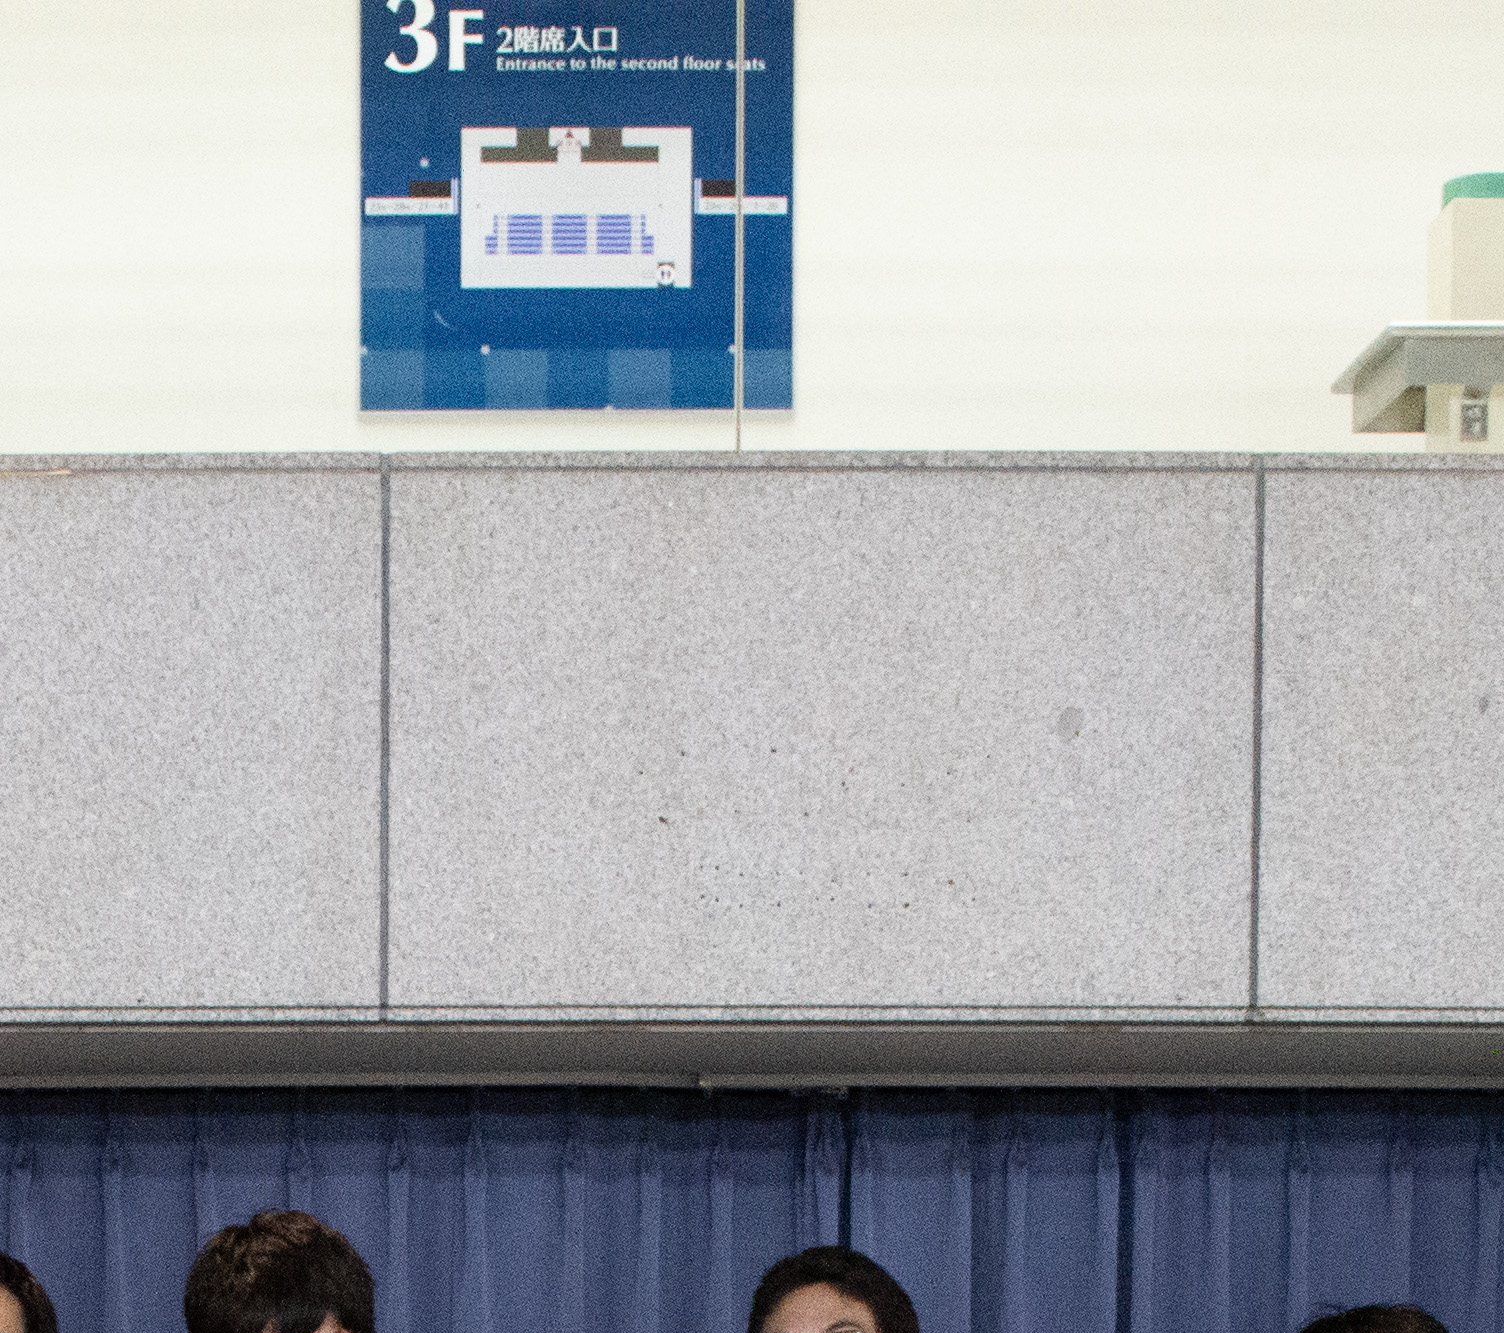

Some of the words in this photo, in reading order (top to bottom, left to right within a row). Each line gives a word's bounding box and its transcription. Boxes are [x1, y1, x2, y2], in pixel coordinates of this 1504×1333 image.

[384, 0, 484, 73] 3F
[495, 25, 618, 53] 2階席入口
[495, 55, 566, 71] Entrance
[569, 57, 587, 71] to
[590, 55, 617, 71] the
[621, 56, 678, 70] second
[683, 55, 722, 70] floor
[726, 58, 766, 71] sats
